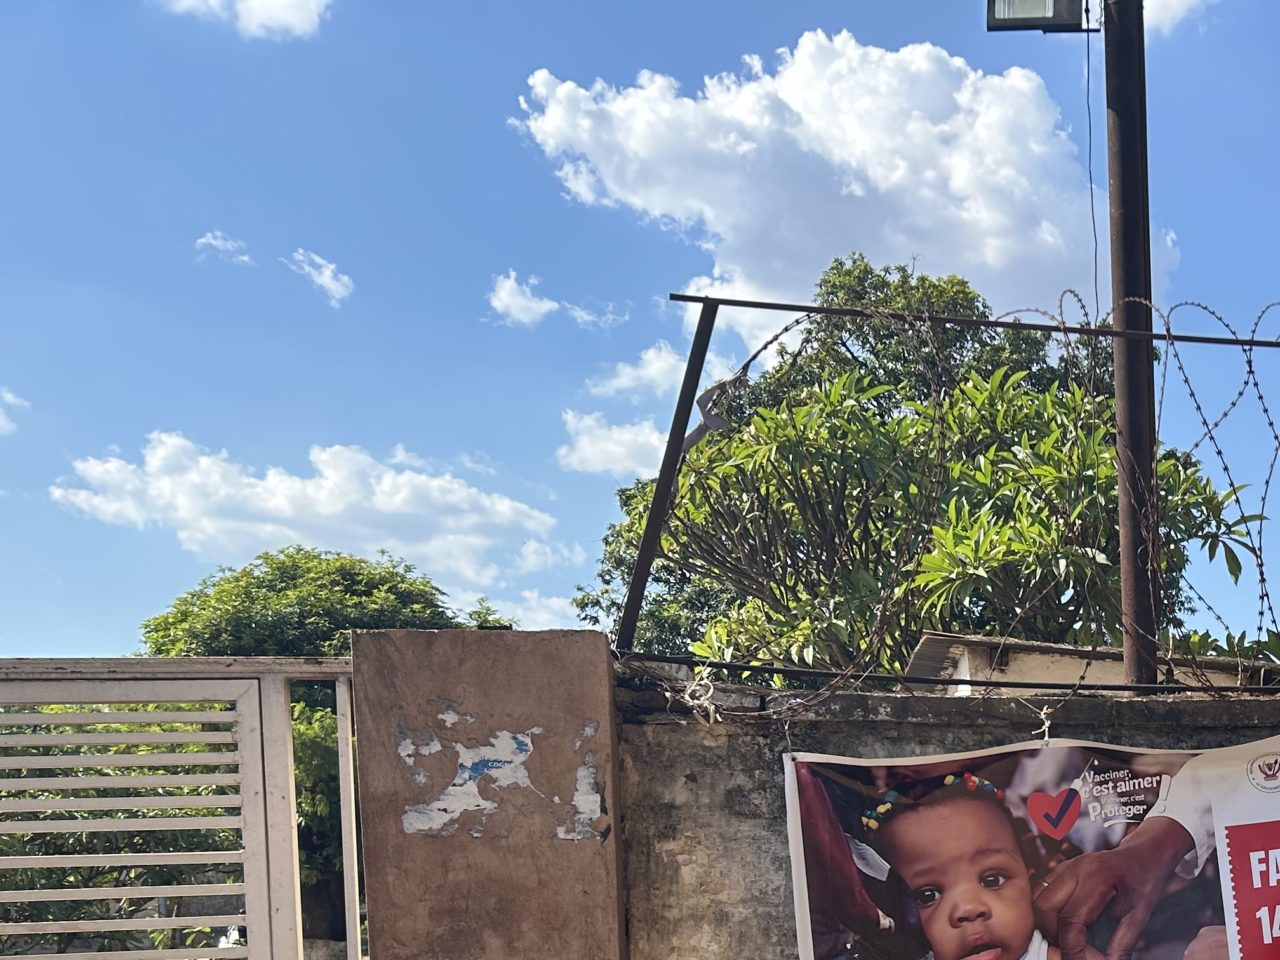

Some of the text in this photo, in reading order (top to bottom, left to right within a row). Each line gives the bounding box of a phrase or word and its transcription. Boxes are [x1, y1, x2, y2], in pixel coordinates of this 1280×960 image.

[1085, 769, 1132, 783] Vacciner,
[1081, 780, 1115, 798] c'est
[1116, 775, 1161, 793] aimer
[1087, 801, 1147, 821] Proteger
